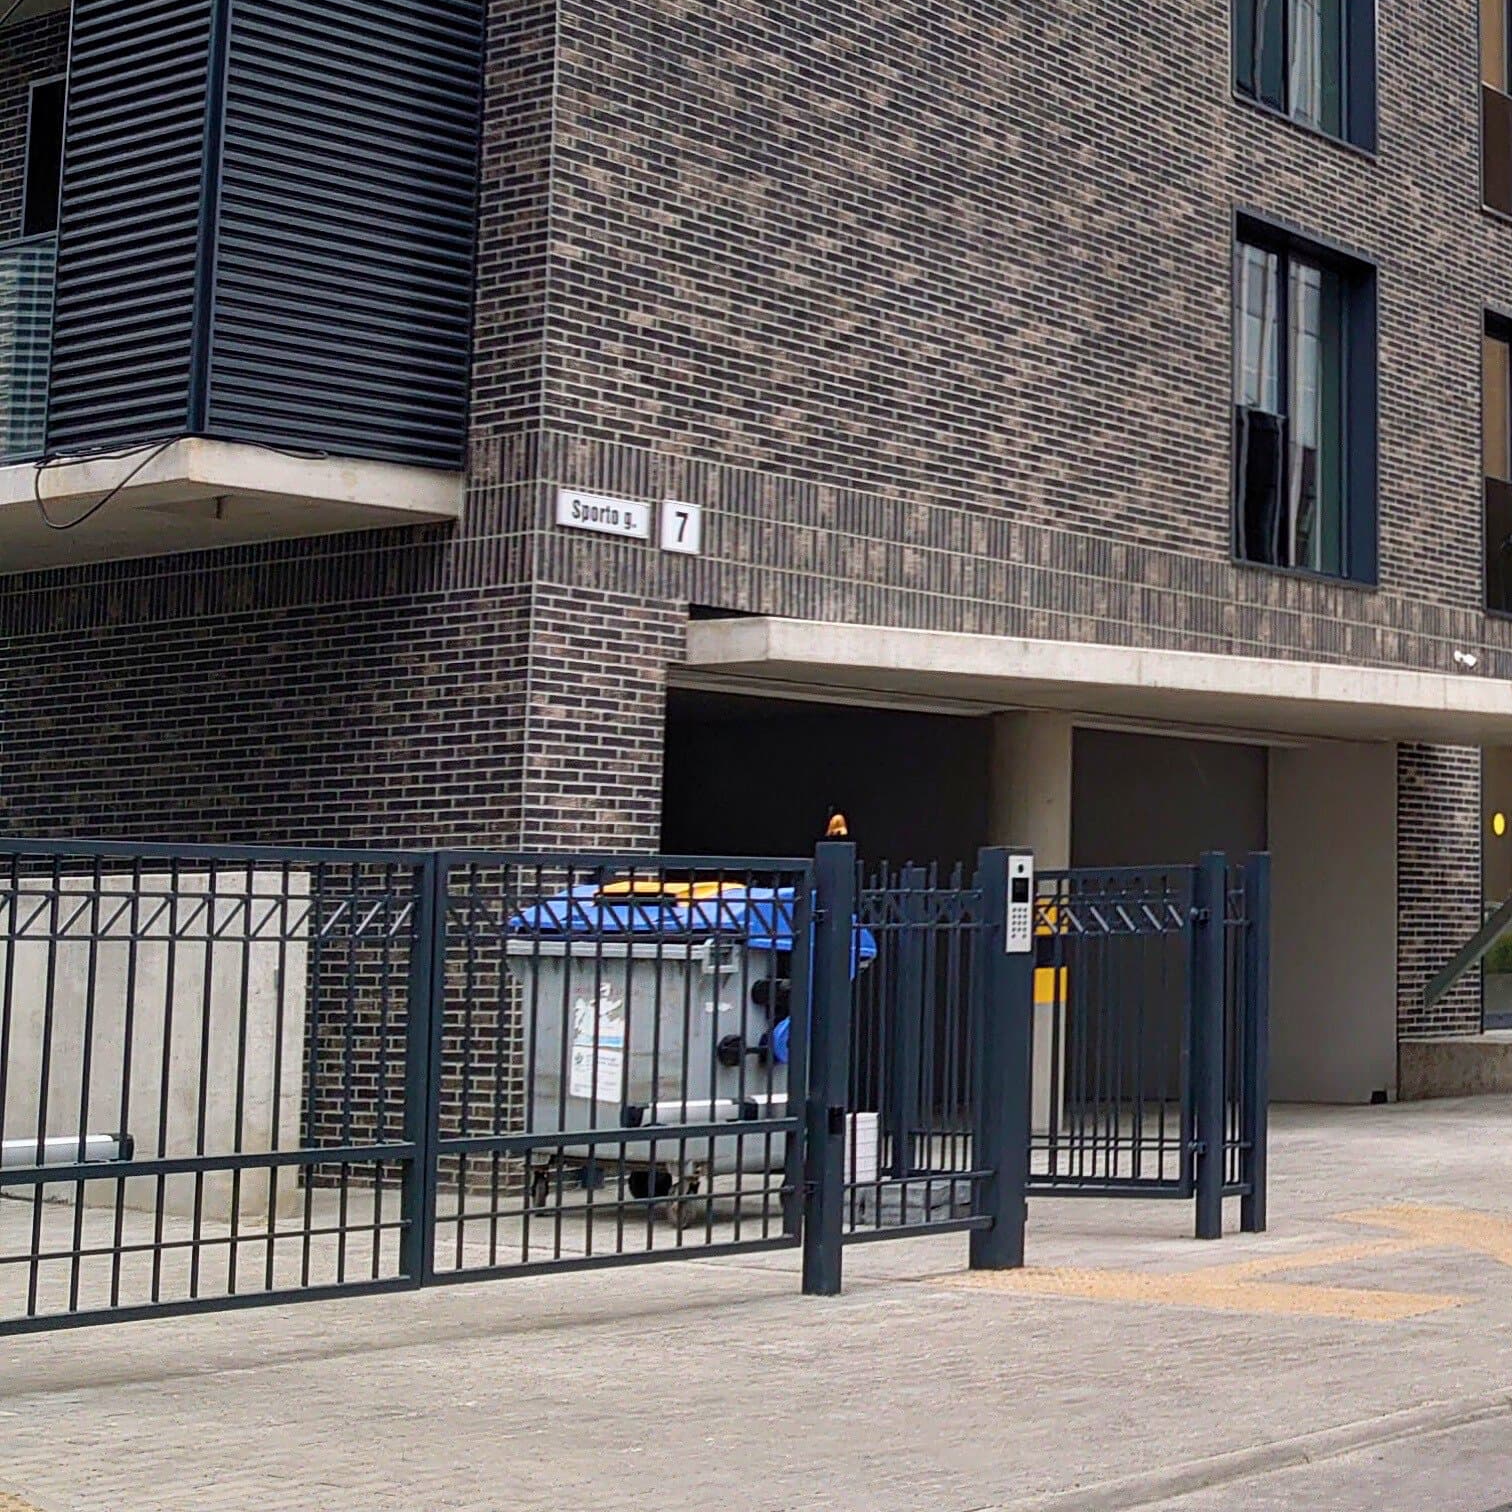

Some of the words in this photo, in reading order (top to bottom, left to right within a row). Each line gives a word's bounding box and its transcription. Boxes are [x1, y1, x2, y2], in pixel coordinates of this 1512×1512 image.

[571, 499, 619, 525] Sporto
[623, 512, 637, 529] g.
[675, 511, 689, 543] 7
